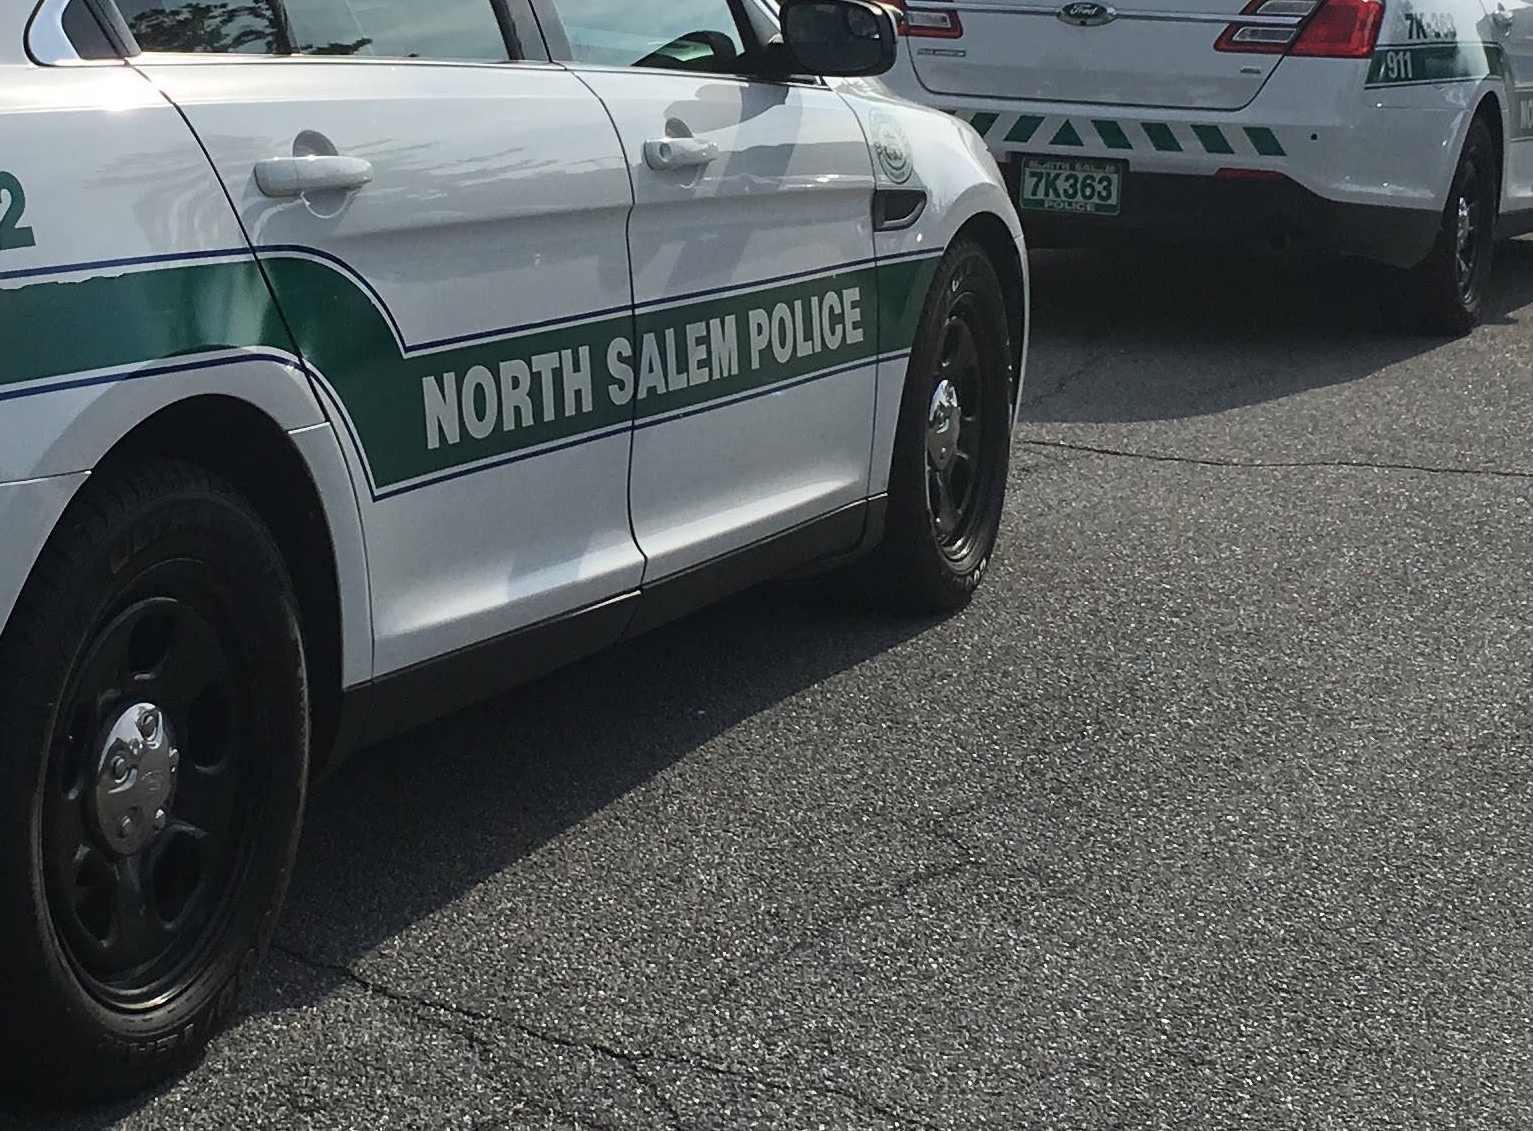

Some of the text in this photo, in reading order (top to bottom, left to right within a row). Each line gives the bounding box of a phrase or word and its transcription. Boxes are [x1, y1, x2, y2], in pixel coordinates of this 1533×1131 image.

[1386, 51, 1413, 79] 911
[1028, 171, 1113, 202] 7K363
[1045, 200, 1096, 211] POLICE
[421, 287, 864, 450] NORTH SALEM POLICE
